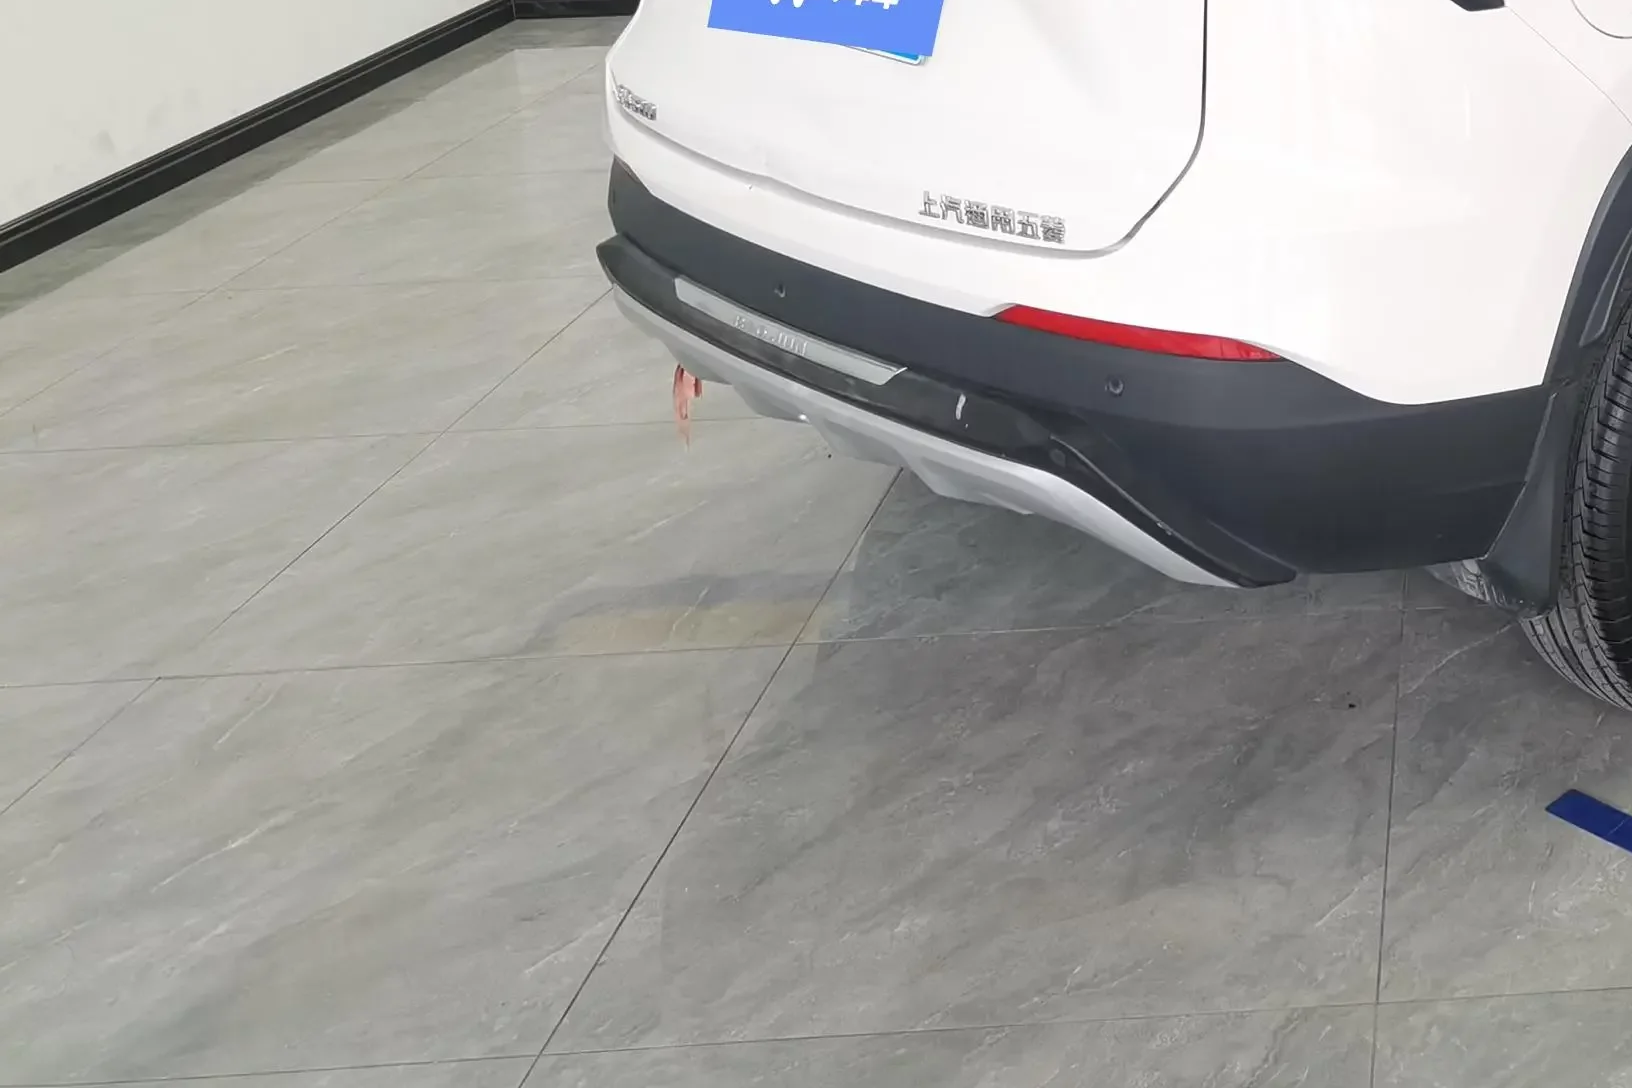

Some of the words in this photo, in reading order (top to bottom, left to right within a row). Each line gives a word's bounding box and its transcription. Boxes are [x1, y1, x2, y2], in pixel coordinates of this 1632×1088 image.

[918, 190, 1066, 244] 上汽通用五菱
